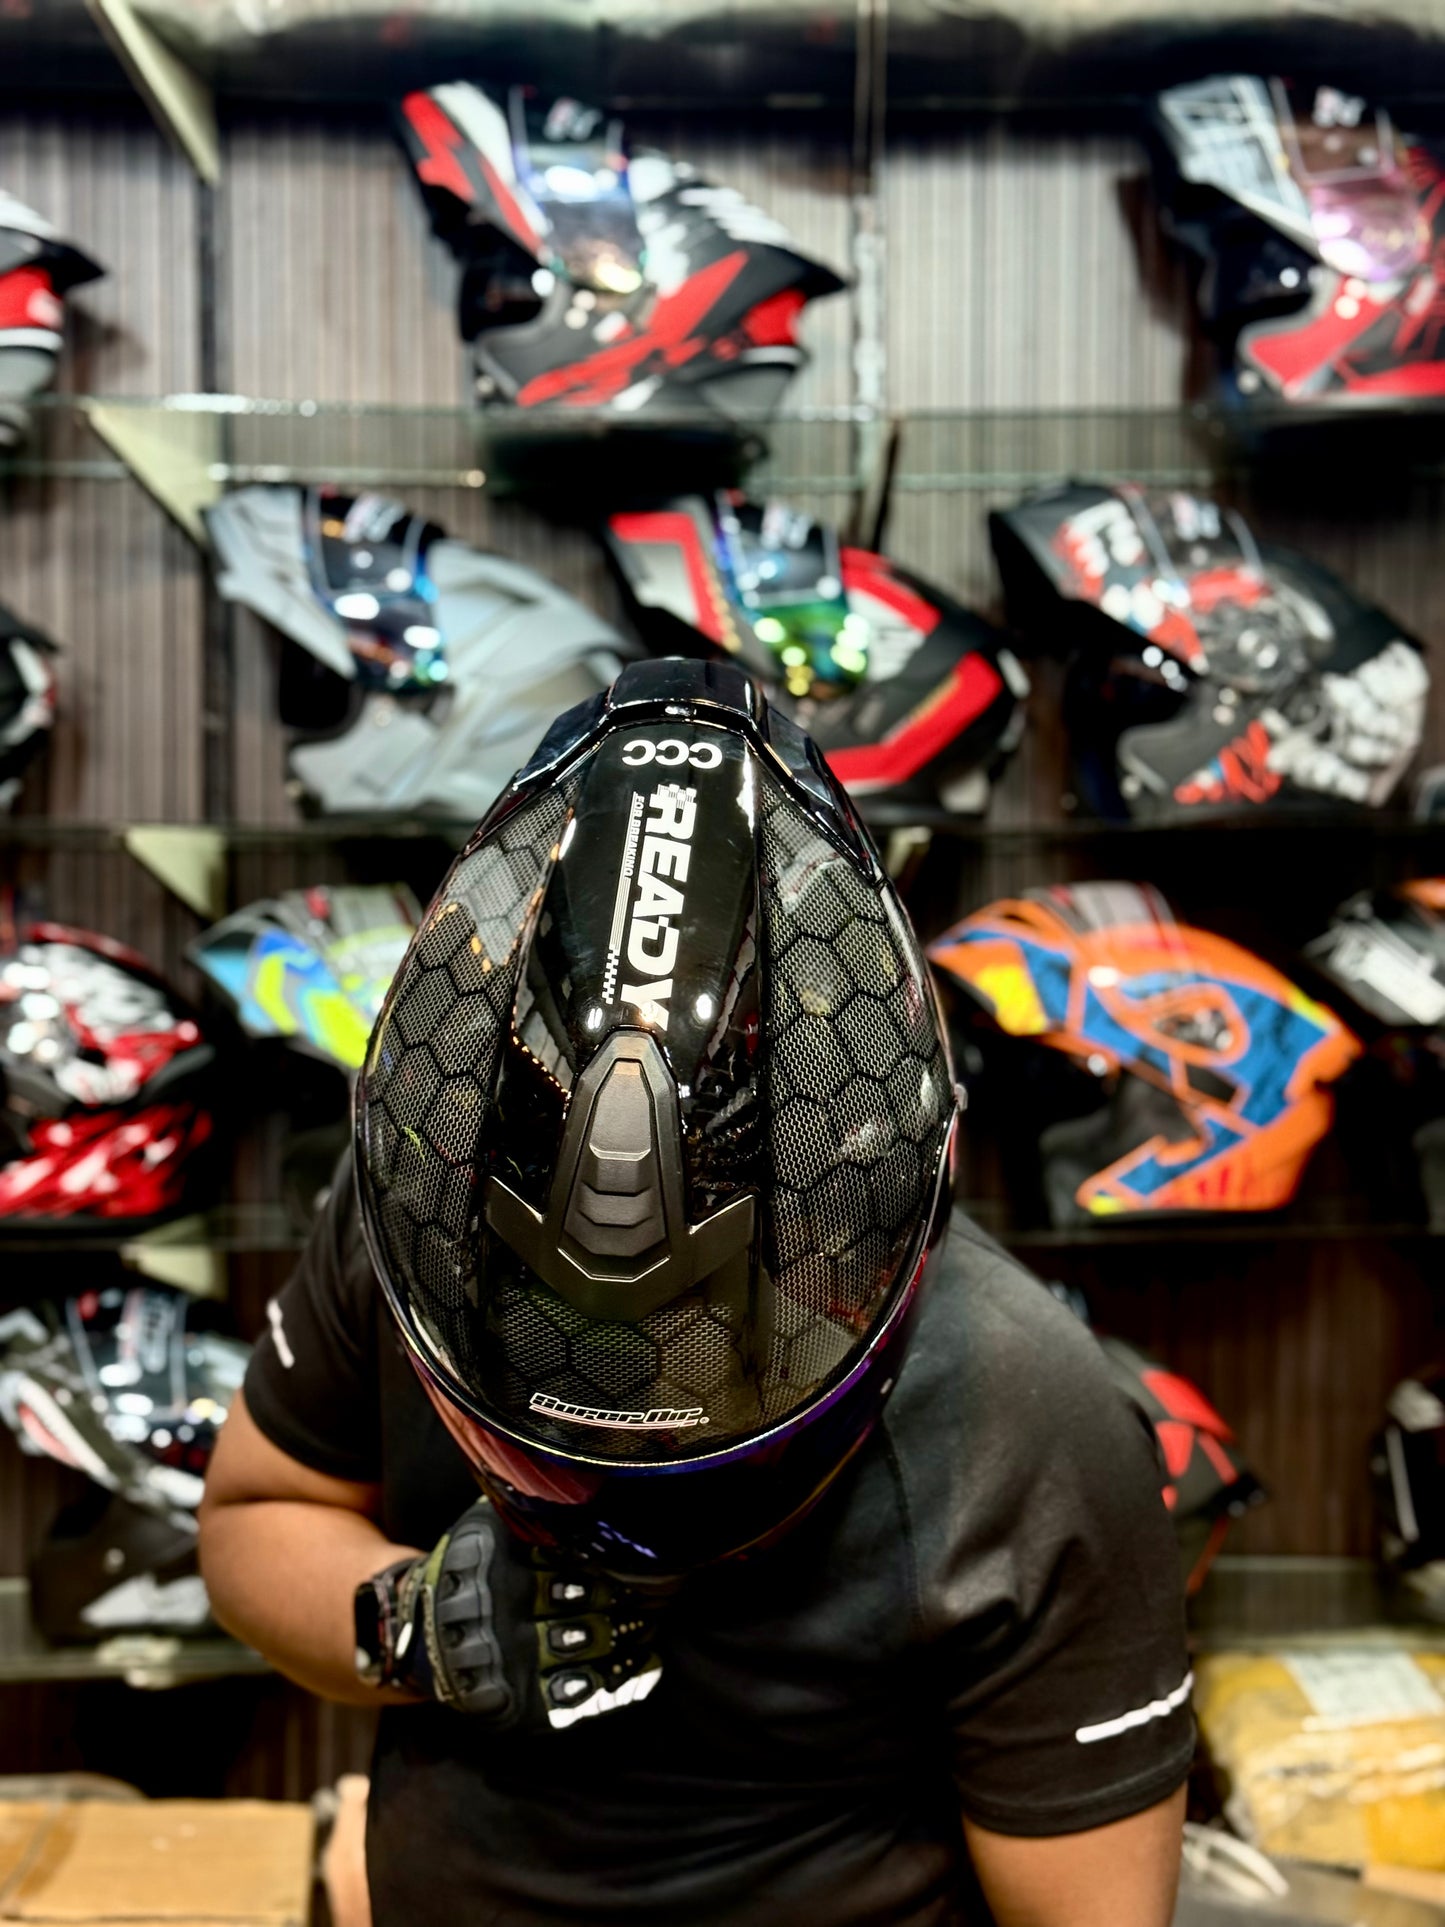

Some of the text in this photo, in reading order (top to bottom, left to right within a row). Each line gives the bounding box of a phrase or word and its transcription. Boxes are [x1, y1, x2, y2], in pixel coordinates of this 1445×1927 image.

[622, 739, 723, 769] CCC
[634, 795, 645, 818] FOR
[620, 784, 698, 1031] READY
